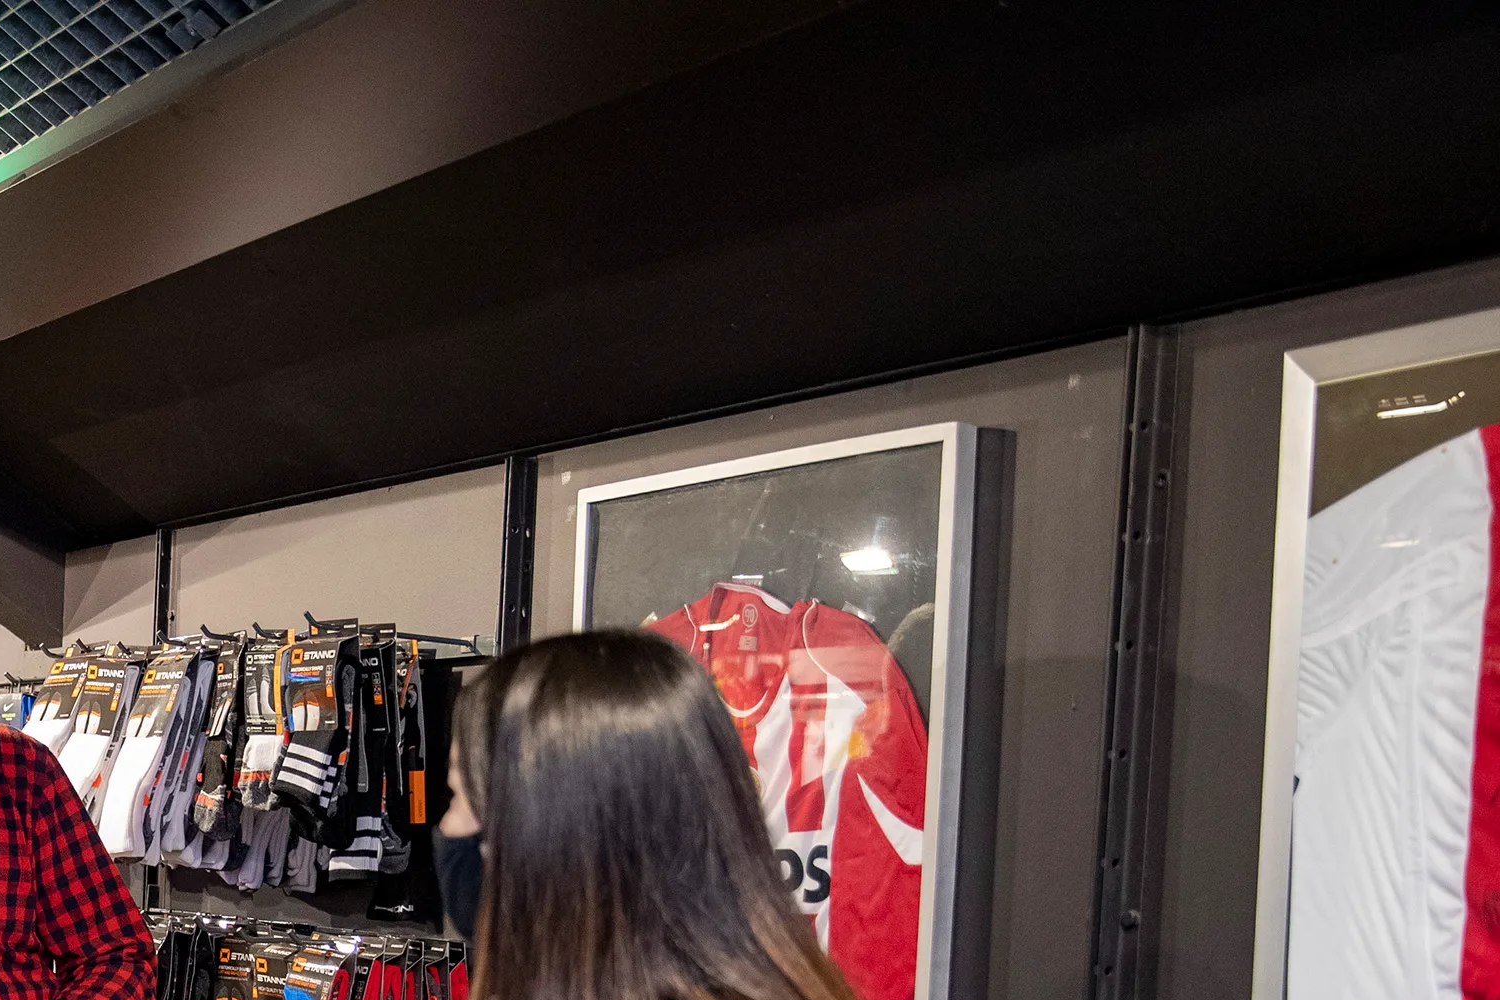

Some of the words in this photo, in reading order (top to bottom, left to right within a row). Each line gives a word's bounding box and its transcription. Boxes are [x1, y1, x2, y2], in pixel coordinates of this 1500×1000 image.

[303, 649, 336, 661] STANNO
[62, 661, 89, 671] STANN
[97, 668, 125, 679] STANNO
[155, 671, 184, 680] STANNO
[230, 952, 255, 962] STANN
